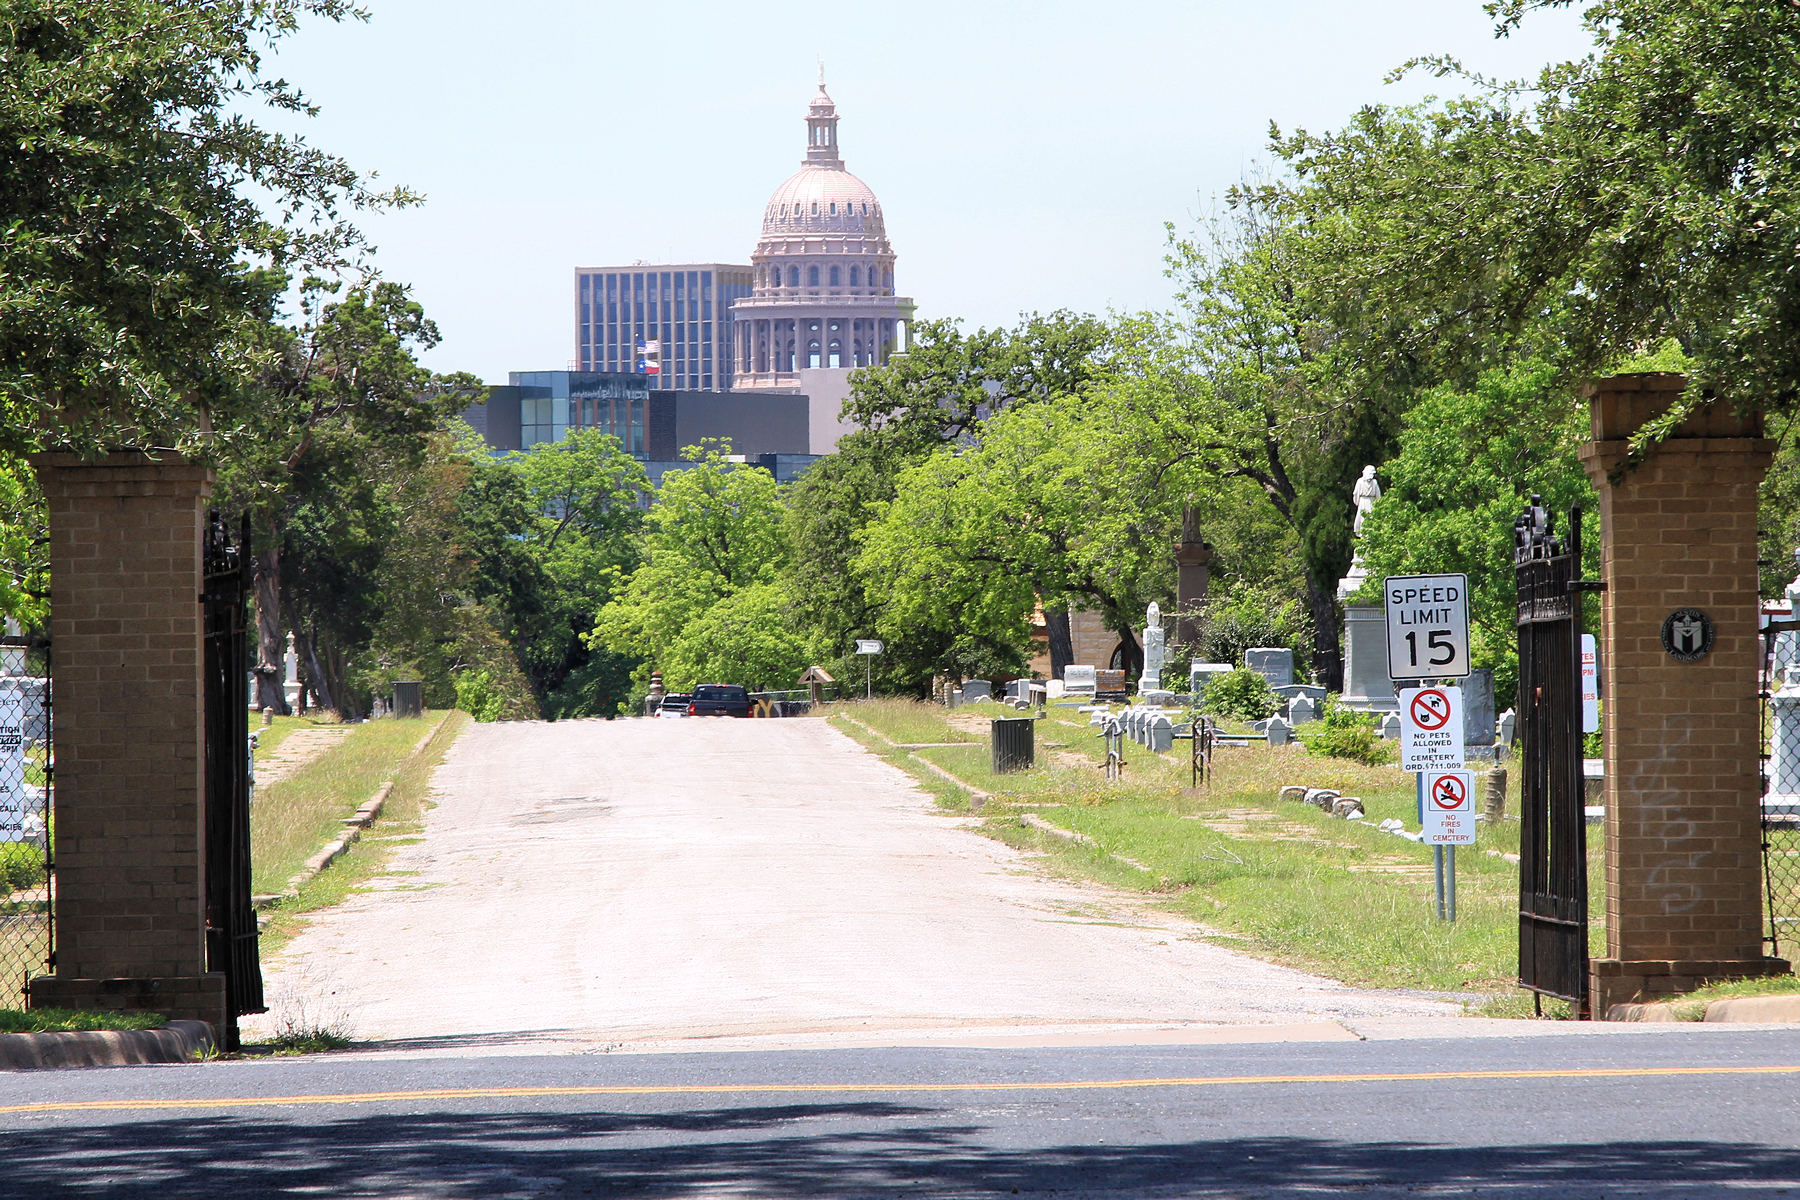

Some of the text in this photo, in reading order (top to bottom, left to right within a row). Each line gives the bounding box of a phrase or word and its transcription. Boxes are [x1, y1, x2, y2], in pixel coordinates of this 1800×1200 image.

[1392, 587, 1459, 604] SPEED
[1400, 609, 1451, 625] LIMIT
[1405, 630, 1456, 666] 15
[1669, 650, 1706, 661] LANDMARK
[1410, 754, 1455, 762] CEMETERY
